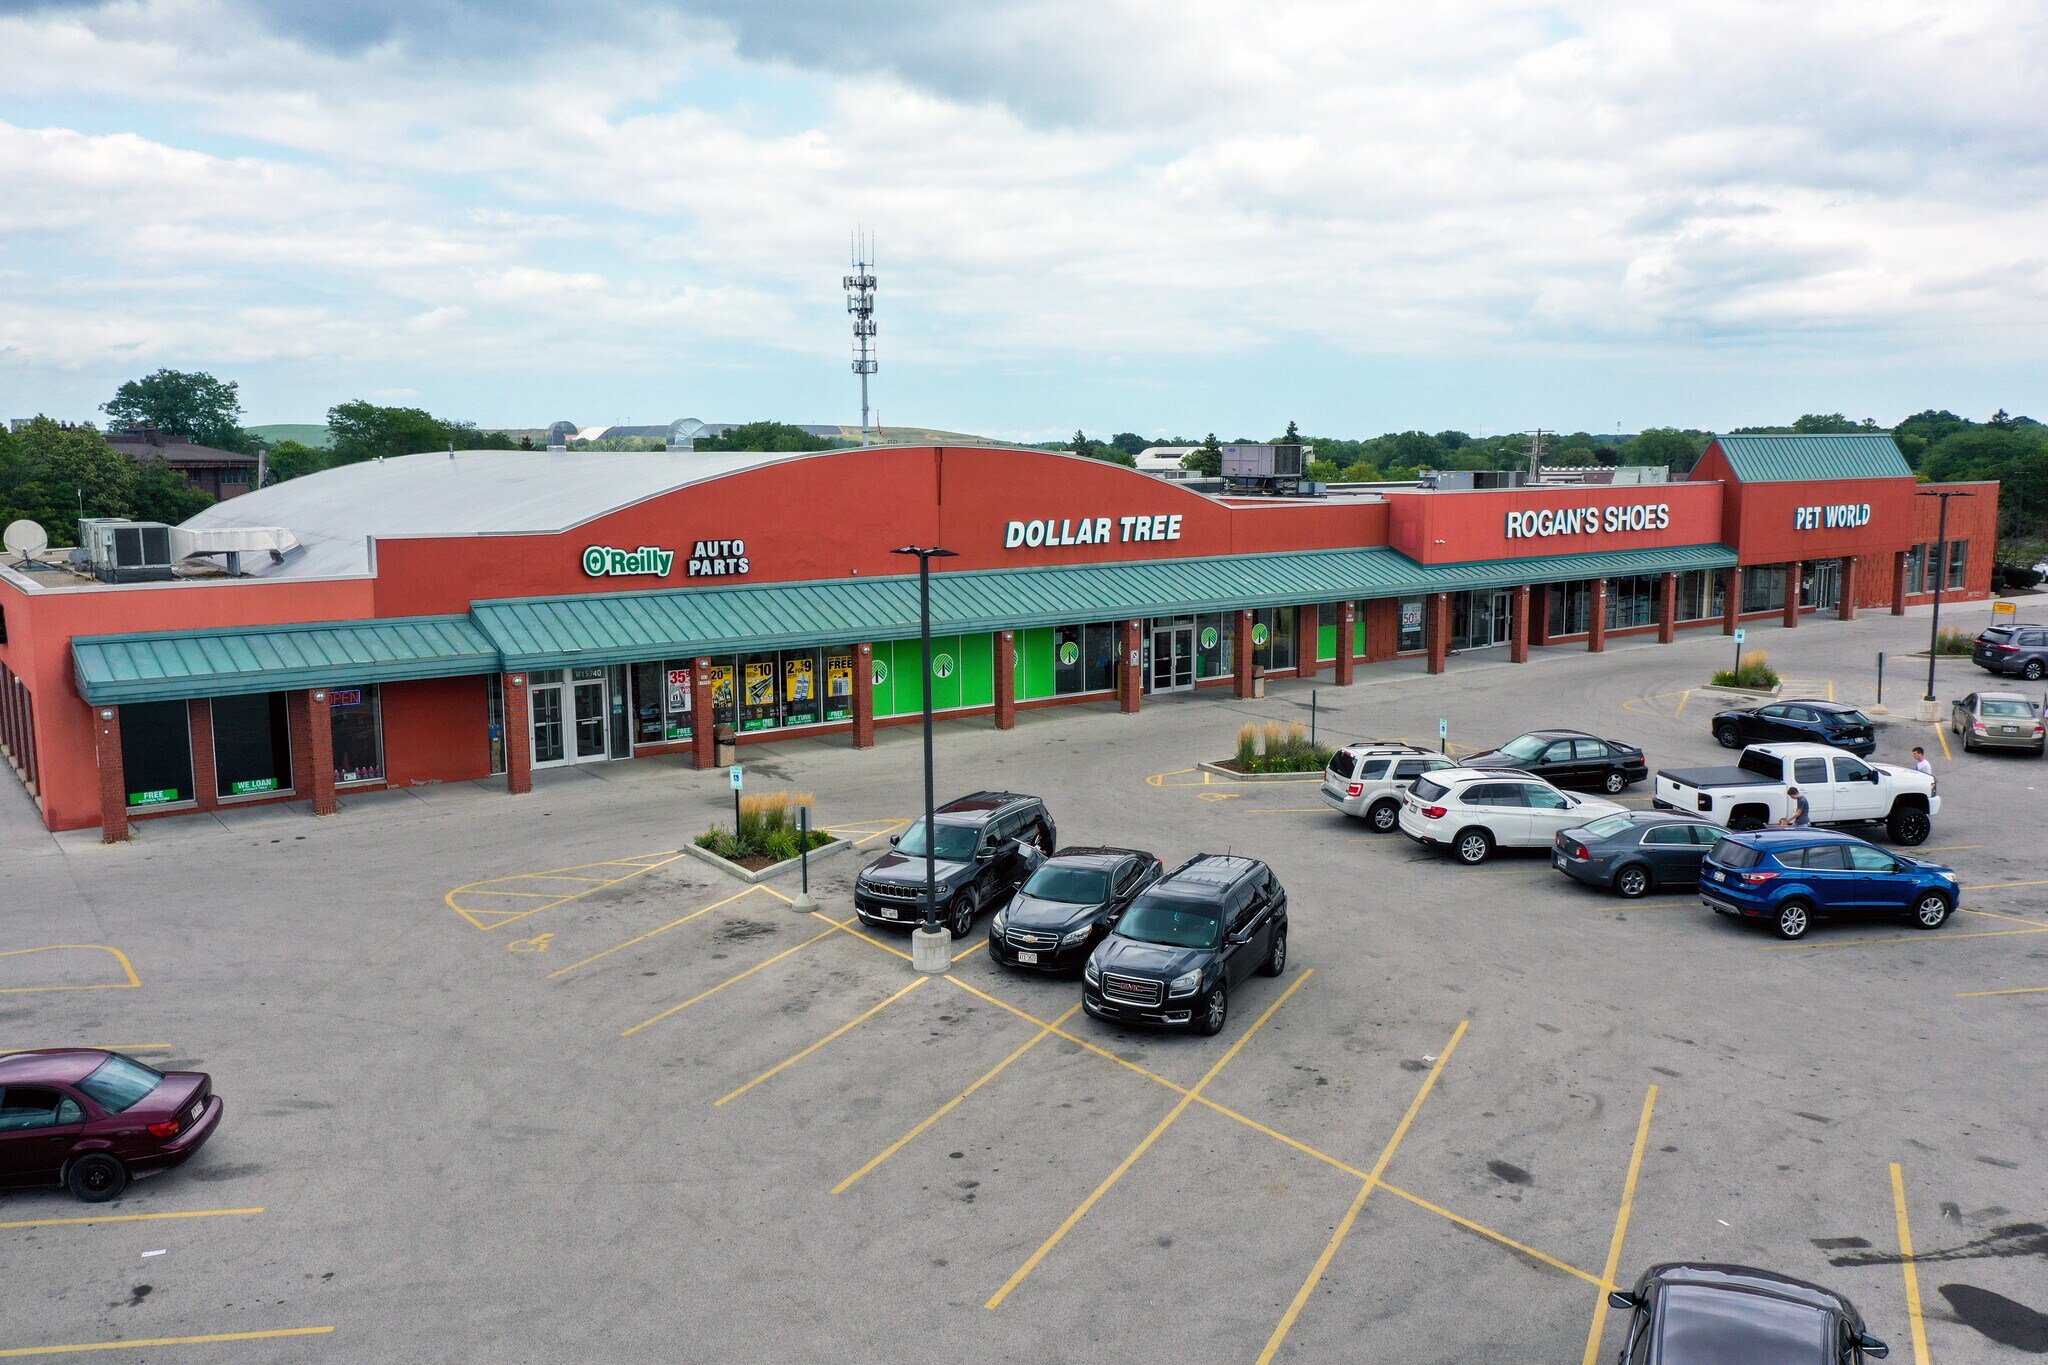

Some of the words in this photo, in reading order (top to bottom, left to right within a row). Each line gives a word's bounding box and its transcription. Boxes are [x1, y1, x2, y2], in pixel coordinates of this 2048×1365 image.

[1506, 507, 1599, 538] ROGAN'S
[1604, 503, 1669, 533] SHOES
[1795, 506, 1822, 530] PET
[1825, 503, 1871, 528] WORLD
[1005, 517, 1112, 548] DOLLAR
[1119, 514, 1183, 542] TREE
[694, 540, 745, 557] AUTO
[585, 548, 672, 575] O'Reilly
[688, 558, 749, 576] PARTS
[753, 663, 771, 677] $10
[787, 661, 795, 674] 2
[800, 660, 811, 673] $9
[829, 660, 852, 670] FREE
[798, 713, 811, 721] TURN
[238, 781, 249, 789] WE
[251, 778, 272, 788] LOAN
[143, 790, 164, 799] FREE
